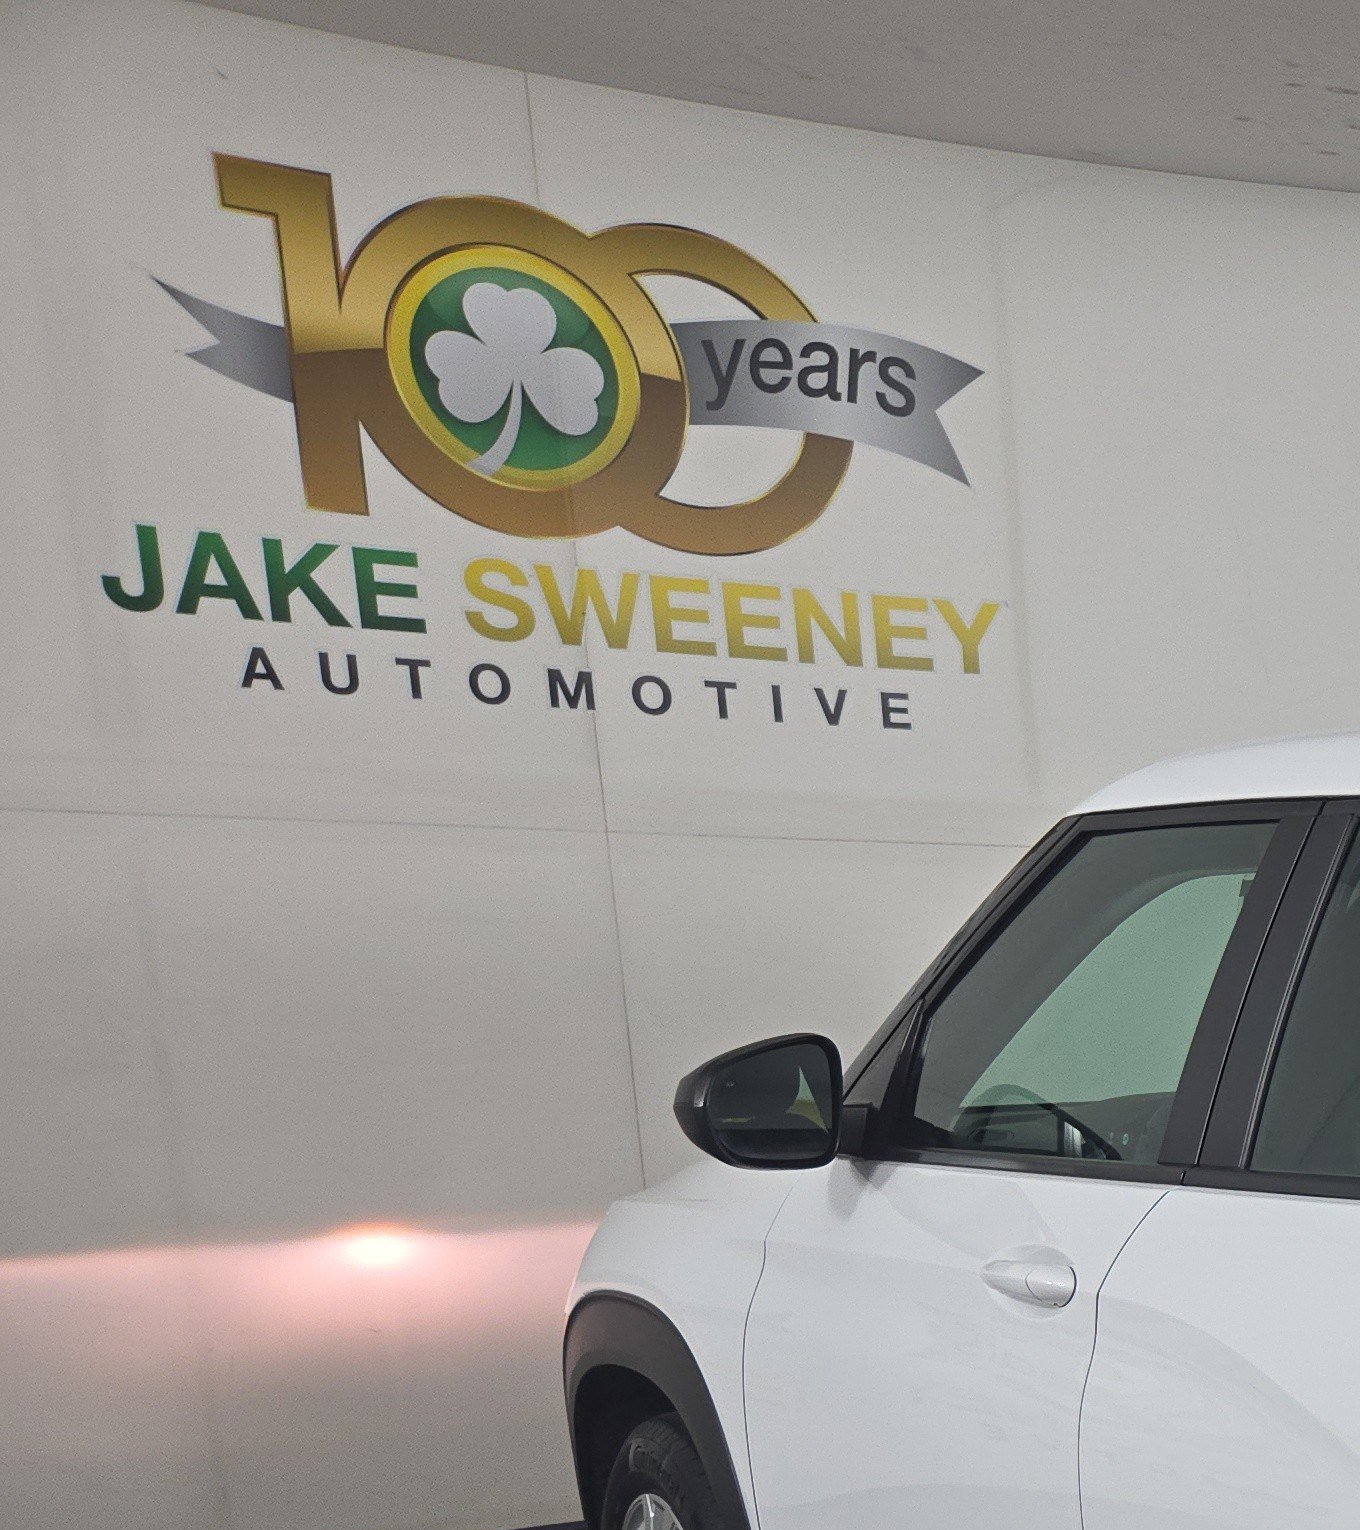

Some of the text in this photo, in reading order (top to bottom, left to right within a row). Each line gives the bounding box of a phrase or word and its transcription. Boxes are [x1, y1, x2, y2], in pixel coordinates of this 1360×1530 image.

[212, 151, 855, 557] 100
[700, 334, 919, 420] years
[101, 522, 1000, 675] JAKE SWEENEY
[240, 647, 913, 731] AUTOMOTIVE
